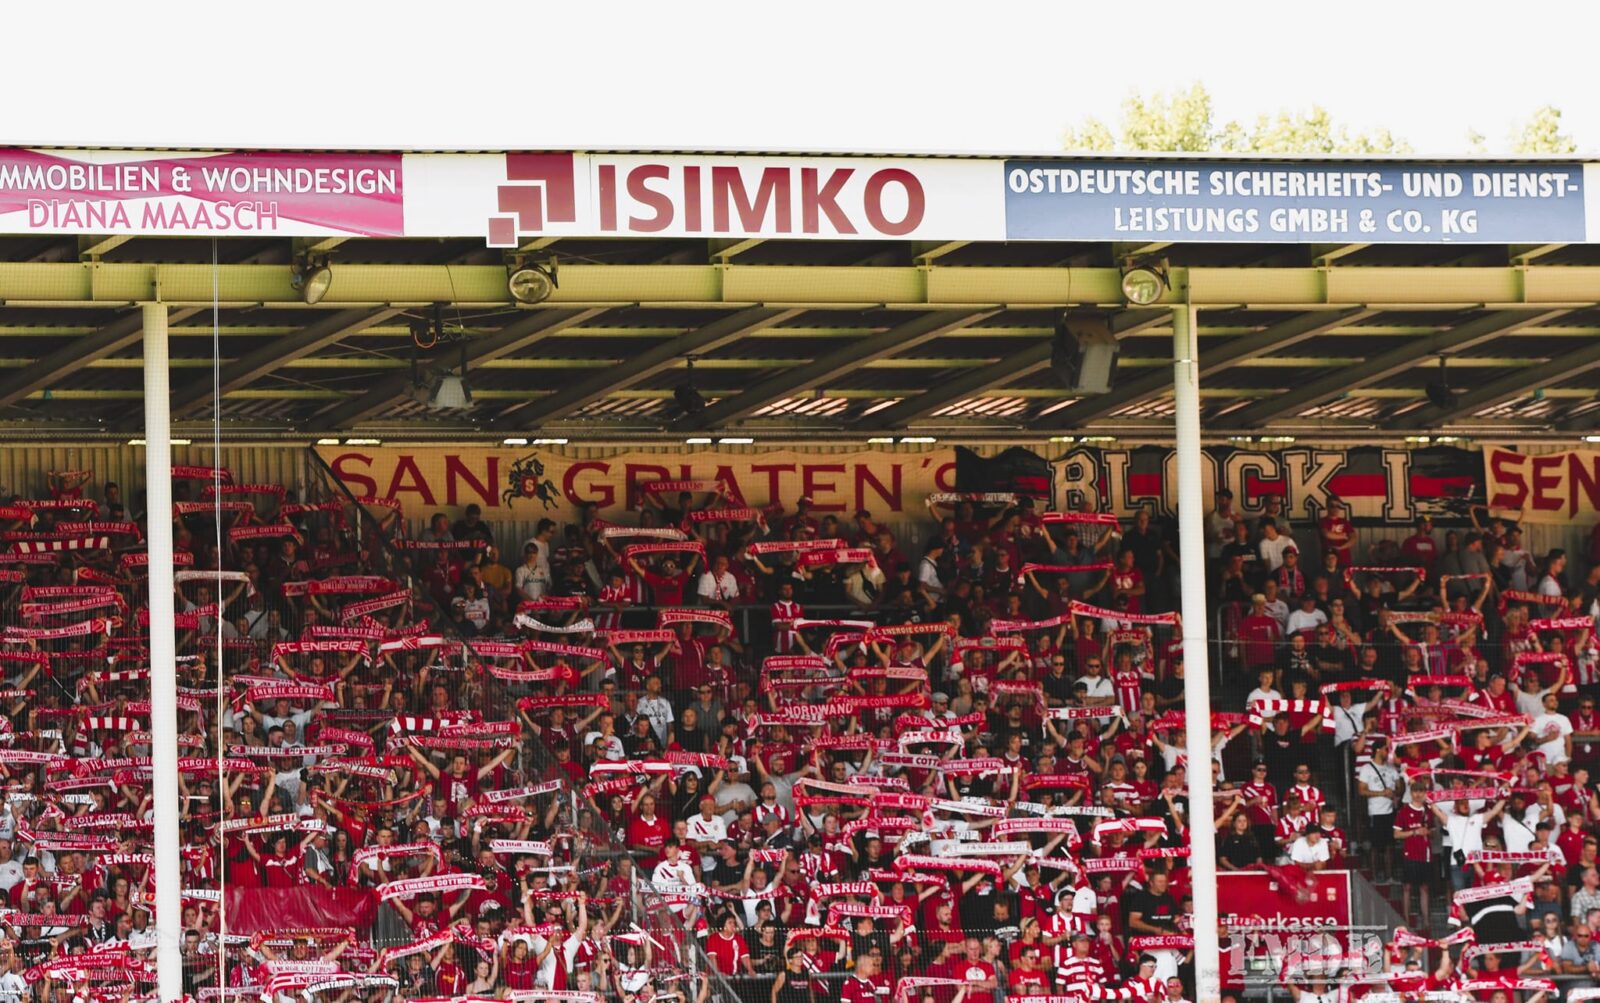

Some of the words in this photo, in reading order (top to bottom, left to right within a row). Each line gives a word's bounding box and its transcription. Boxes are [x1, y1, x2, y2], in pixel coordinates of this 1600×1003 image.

[171, 166, 192, 192] &
[201, 167, 397, 195] WOHNDESIGN
[1008, 169, 1200, 196] OSTDEUTSCHE
[1209, 171, 1394, 198] SICHERHEITS-
[1402, 172, 1463, 198] UND
[1472, 172, 1579, 198] DIENST-
[598, 163, 926, 237] ISIMKO
[27, 199, 134, 229] DIANA
[141, 201, 279, 231] MAASCH
[1113, 207, 1259, 233] LEISTUNGS
[1269, 208, 1349, 233] GMBH
[1358, 209, 1377, 234] &
[1386, 209, 1432, 234] CO.
[1441, 209, 1478, 234] KG
[331, 453, 500, 507] SAN
[1047, 448, 1350, 522] BLOCK
[1381, 449, 1418, 523] I
[691, 511, 706, 521] FC
[708, 508, 752, 520] ENERGI
[1551, 617, 1592, 629] ENERG
[881, 625, 913, 635] ENERGIE
[278, 642, 298, 653] FC
[300, 640, 363, 652] ENERGIE
[253, 687, 287, 697] ENERGIE
[287, 686, 325, 696] COTTBUS
[784, 702, 854, 719] NORDWAND
[1068, 707, 1114, 719] ENERGIE
[89, 760, 101, 770] FC
[102, 757, 134, 768] ENERGIE
[915, 758, 939, 768] COTT
[97, 813, 132, 823] COTTB
[268, 815, 298, 823] COTT
[103, 853, 152, 865] ENERG
[436, 877, 473, 888] COTTBUS
[815, 882, 873, 897] ENERGIE
[1228, 911, 1338, 934] rkasse
